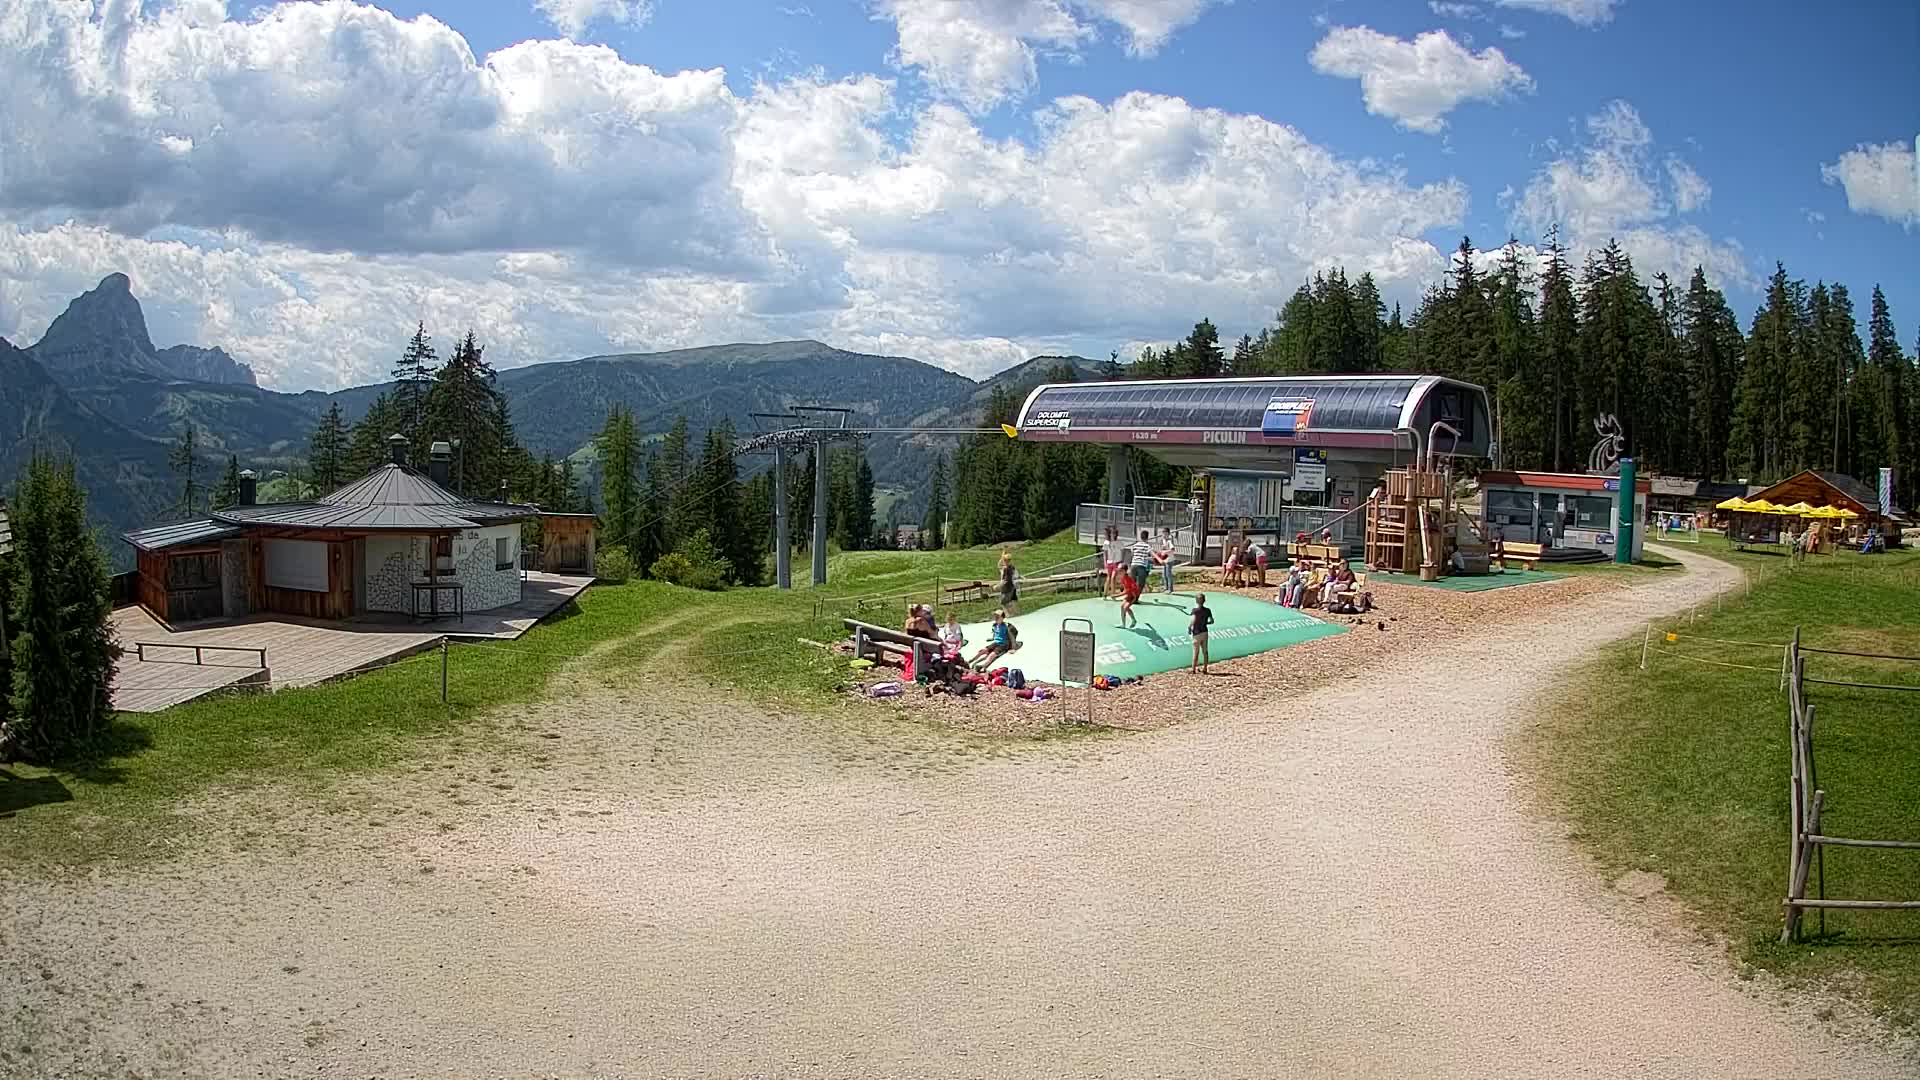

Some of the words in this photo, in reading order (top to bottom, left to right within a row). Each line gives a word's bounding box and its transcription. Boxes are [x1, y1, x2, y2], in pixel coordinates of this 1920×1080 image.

[1026, 418, 1059, 426] SUPERSKI
[1203, 431, 1247, 444] PICULIN
[1208, 628, 1237, 640] MIND
